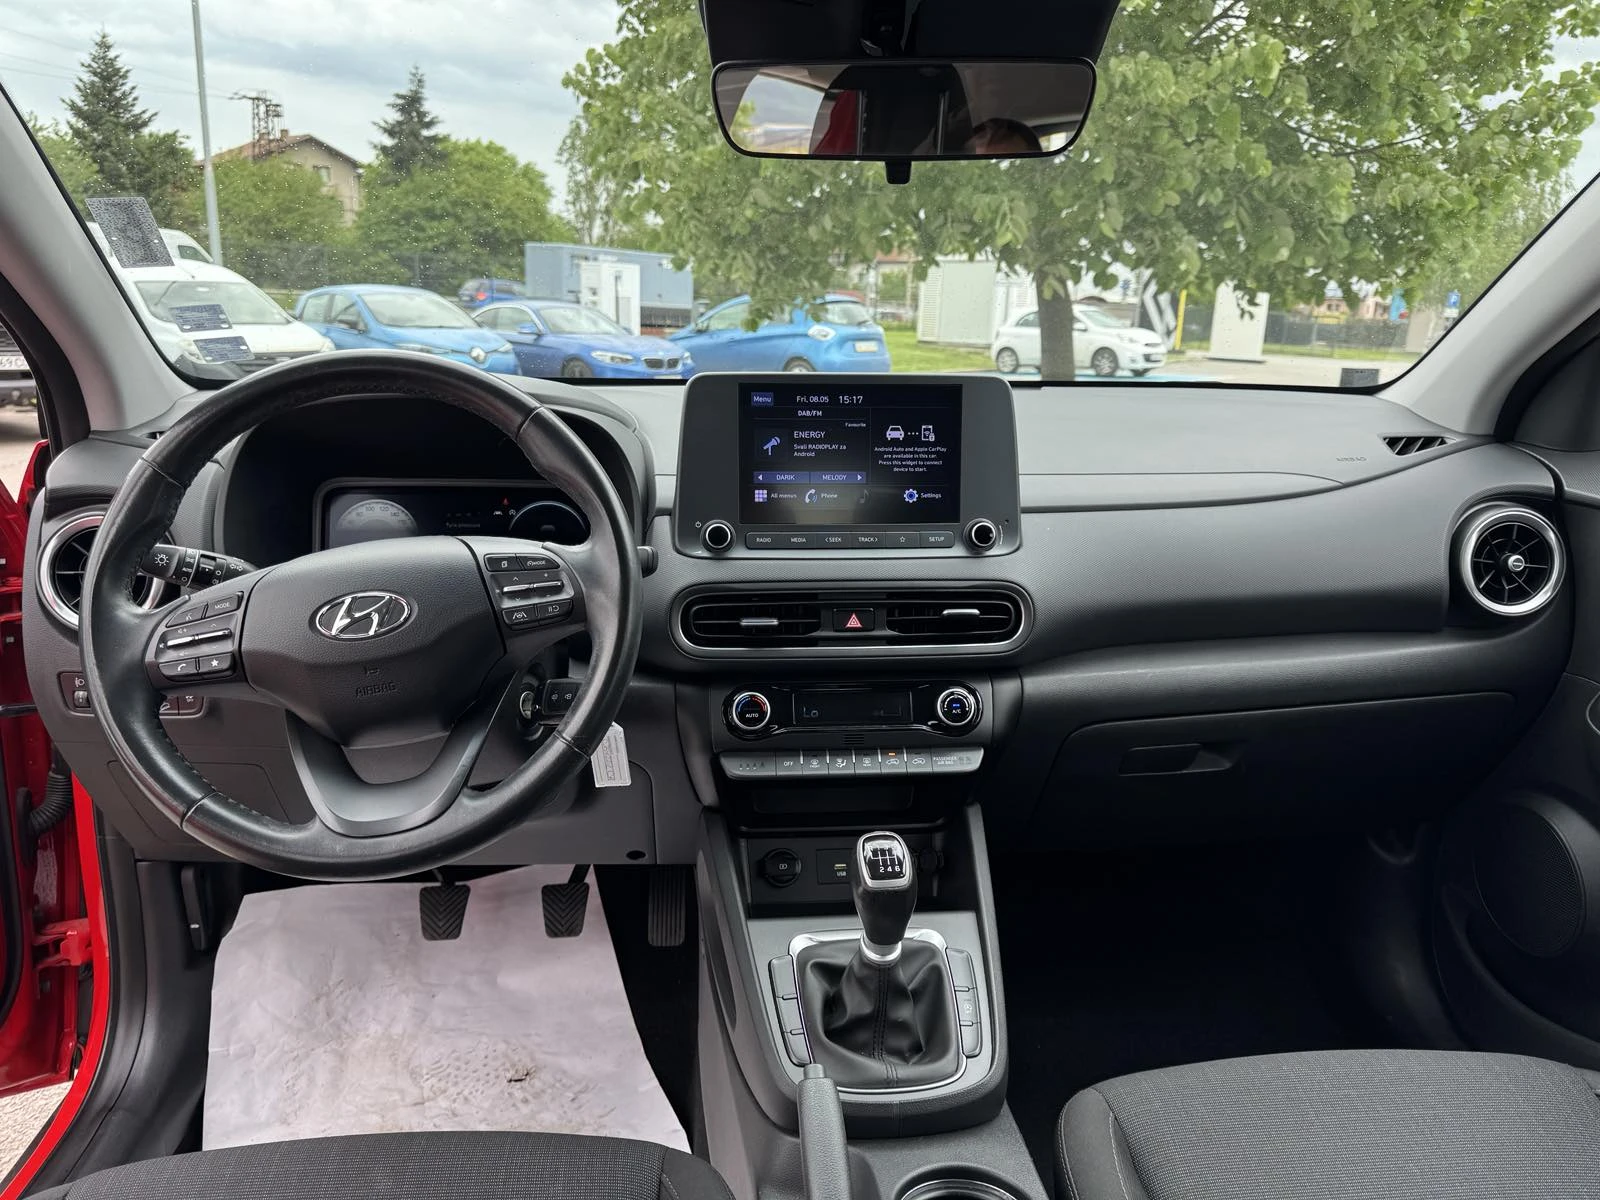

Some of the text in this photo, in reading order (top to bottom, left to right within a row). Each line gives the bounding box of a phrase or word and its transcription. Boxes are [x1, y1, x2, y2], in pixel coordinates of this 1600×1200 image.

[753, 395, 772, 403] Menu
[809, 395, 829, 403] 08.05
[838, 395, 864, 404] 15:17
[793, 431, 826, 439] ENERGY
[214, 601, 230, 609] MODE
[355, 681, 397, 697] AIRBAG
